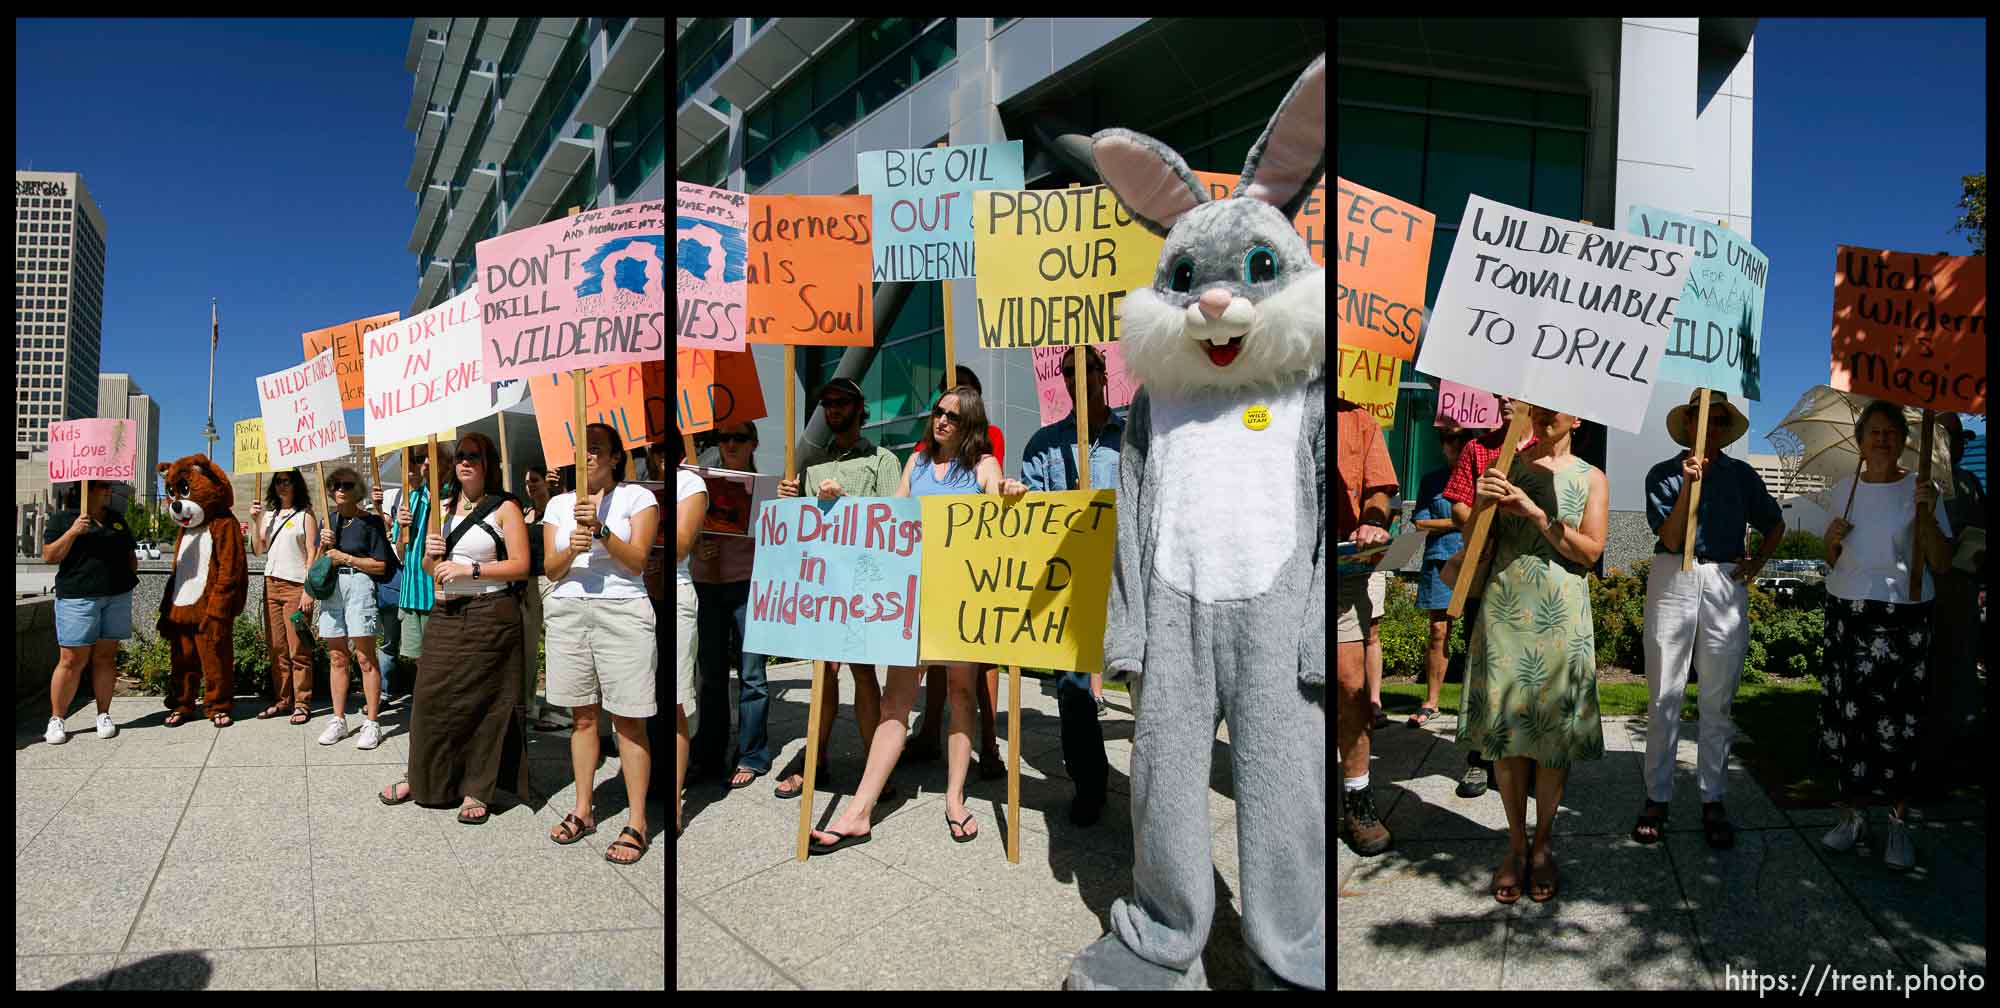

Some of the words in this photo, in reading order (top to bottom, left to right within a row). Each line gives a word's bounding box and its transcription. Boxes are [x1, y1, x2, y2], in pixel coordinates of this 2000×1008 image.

[885, 150, 936, 188] BIG
[944, 147, 994, 183] OIL
[752, 205, 870, 245] derness
[890, 191, 961, 233] OUT
[563, 228, 584, 242] AND
[1472, 208, 1685, 277] WILDERNESS
[486, 244, 581, 294] DON'T
[1038, 238, 1118, 282] OUR
[1727, 240, 1767, 289] UTAHN
[1846, 252, 1937, 294] Utah
[483, 291, 561, 325] DRILL
[792, 283, 865, 334] Soul
[369, 331, 399, 359] NO
[403, 348, 431, 379] IN
[1466, 306, 1515, 346] TO
[1531, 324, 1649, 385] DRILL
[1896, 335, 1935, 359] is
[1035, 358, 1064, 382] Wild
[296, 411, 315, 432] MY
[1441, 392, 1488, 424] Public
[51, 425, 81, 442] Kids
[73, 442, 106, 458] Love
[278, 420, 346, 456] BACKYARD
[49, 450, 136, 479] Wilderness!
[760, 505, 788, 547] No
[797, 503, 859, 546] Drill
[864, 503, 923, 557] Rigs
[944, 500, 1114, 548] PROTECT
[799, 551, 827, 586] in
[964, 556, 1073, 593] WILD
[752, 574, 918, 640] Wilderness!
[957, 599, 1070, 646] UTAH
